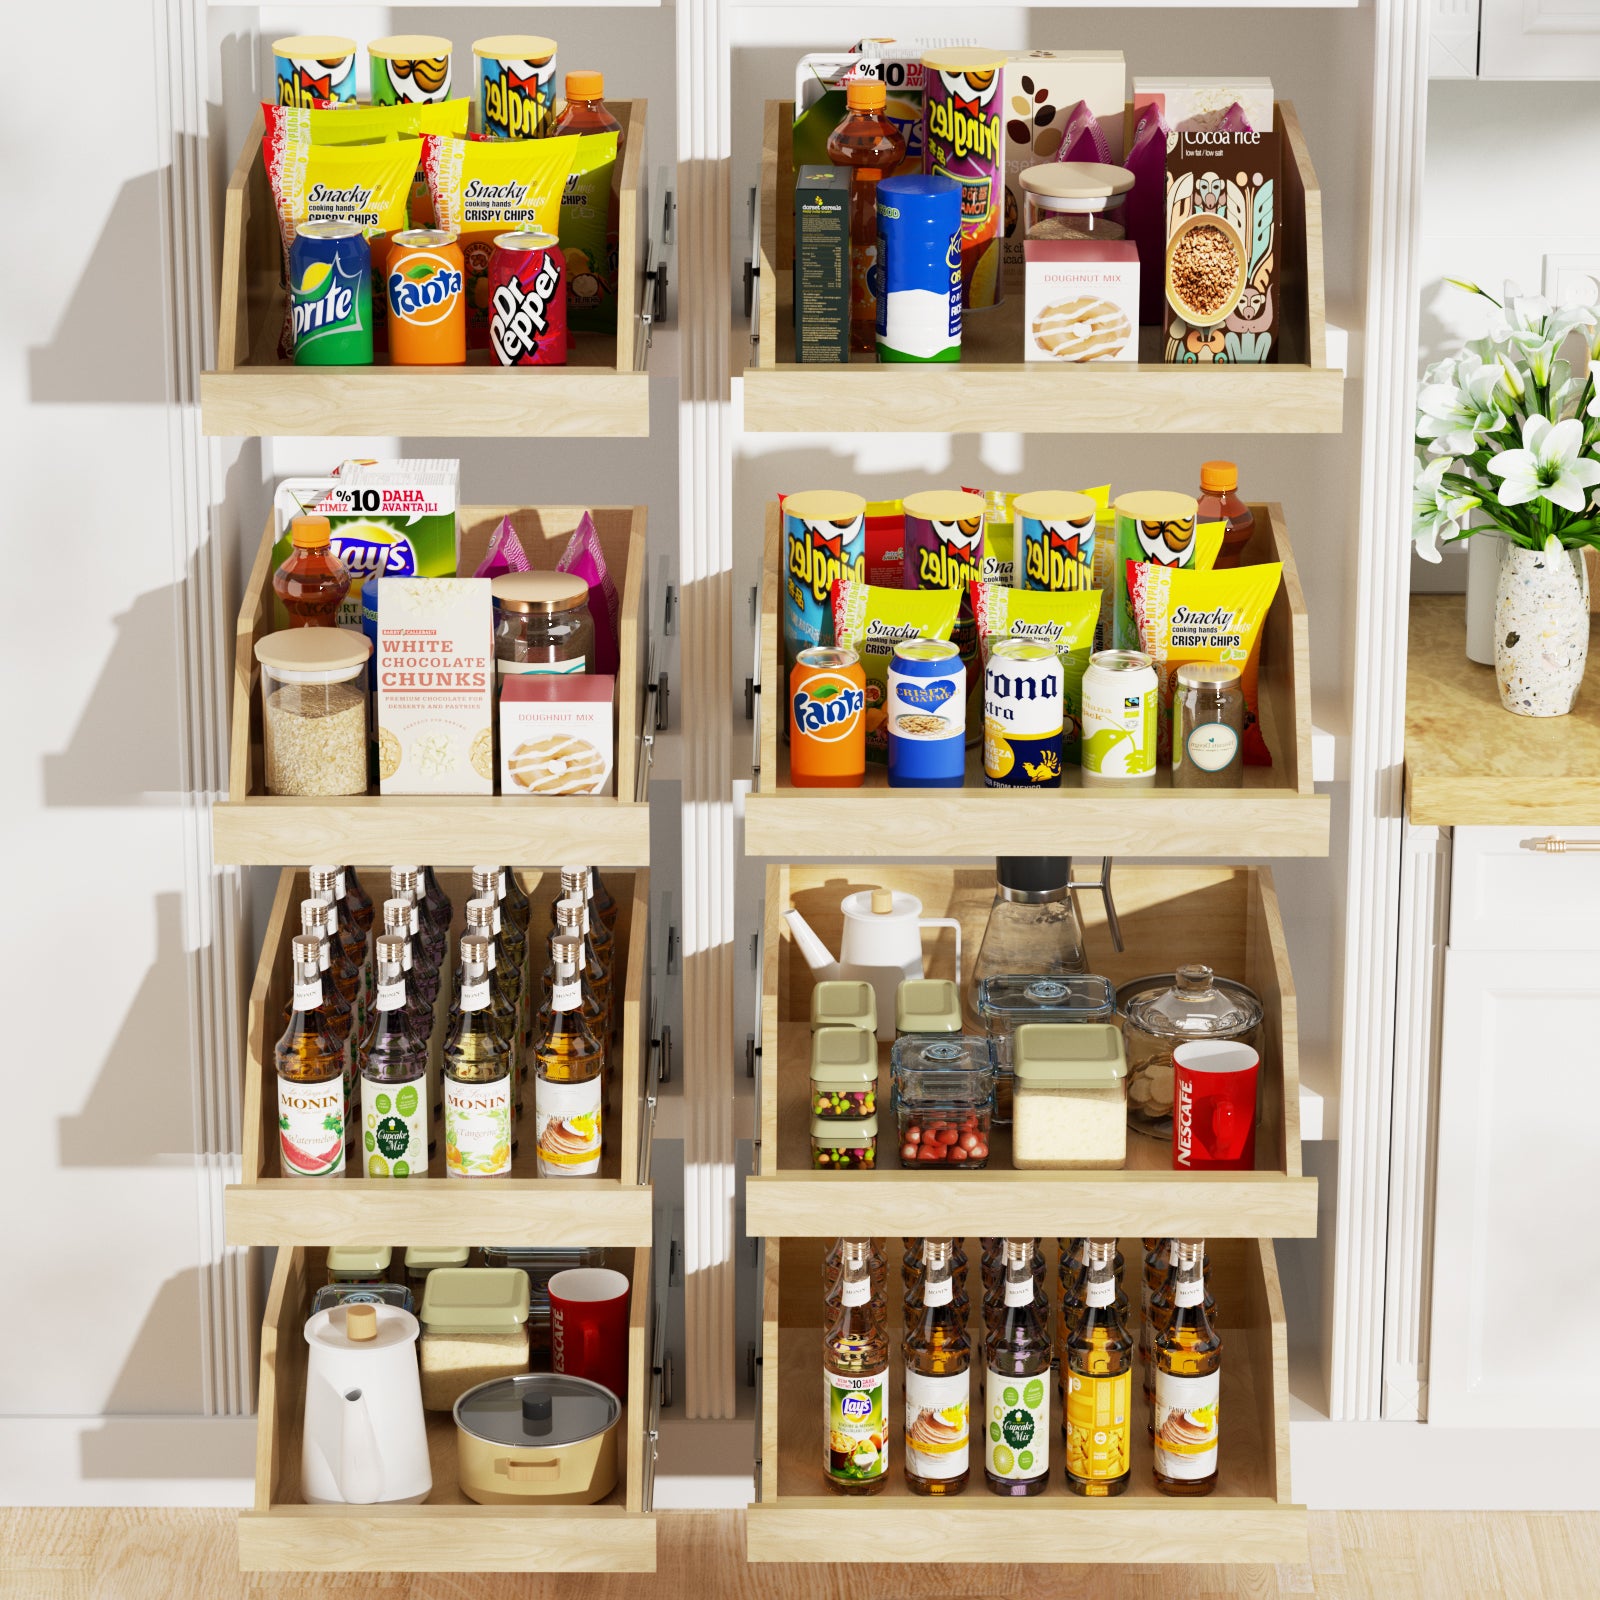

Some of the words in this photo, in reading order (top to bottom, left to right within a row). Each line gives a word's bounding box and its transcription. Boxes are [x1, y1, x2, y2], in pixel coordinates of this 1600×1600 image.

[1184, 131, 1230, 145] Cocoa
[1235, 131, 1261, 145] rice
[309, 184, 372, 210] Snacky
[465, 180, 529, 206] Snacky
[309, 204, 334, 213] cooking
[336, 204, 355, 212] hands
[465, 201, 490, 209] cooking
[492, 200, 512, 208] hands
[465, 209, 501, 221] CRISPY
[504, 209, 534, 221] CHIPS
[1044, 274, 1099, 283] DOUGHNUT
[1103, 274, 1121, 282] MIX
[490, 252, 562, 366] Pepper
[492, 276, 526, 328] Dr
[291, 276, 352, 345] prite
[336, 489, 381, 512] %10
[382, 490, 425, 502] DAHA
[381, 503, 438, 513] AVANTAJLI
[1172, 606, 1234, 632] Snacky
[867, 620, 920, 640] Snacky
[1011, 619, 1063, 641] Snacky
[1172, 626, 1197, 634] cooking
[1198, 626, 1218, 634] hands
[382, 640, 453, 653] WHITE
[1172, 635, 1208, 646] CRISPY
[1211, 635, 1240, 646] CHIPS
[382, 657, 486, 668] CHOCOLATE
[382, 672, 486, 687] CHUNKS
[518, 713, 573, 722] DOUGHNUT
[576, 713, 594, 722] MIX
[281, 1092, 338, 1110] MONIN
[448, 1093, 506, 1110] MONIN
[377, 1128, 408, 1143] Cupcake
[389, 1140, 404, 1151] Mix
[1004, 1420, 1034, 1434] Cupcake
[1014, 1430, 1030, 1442] Mix
